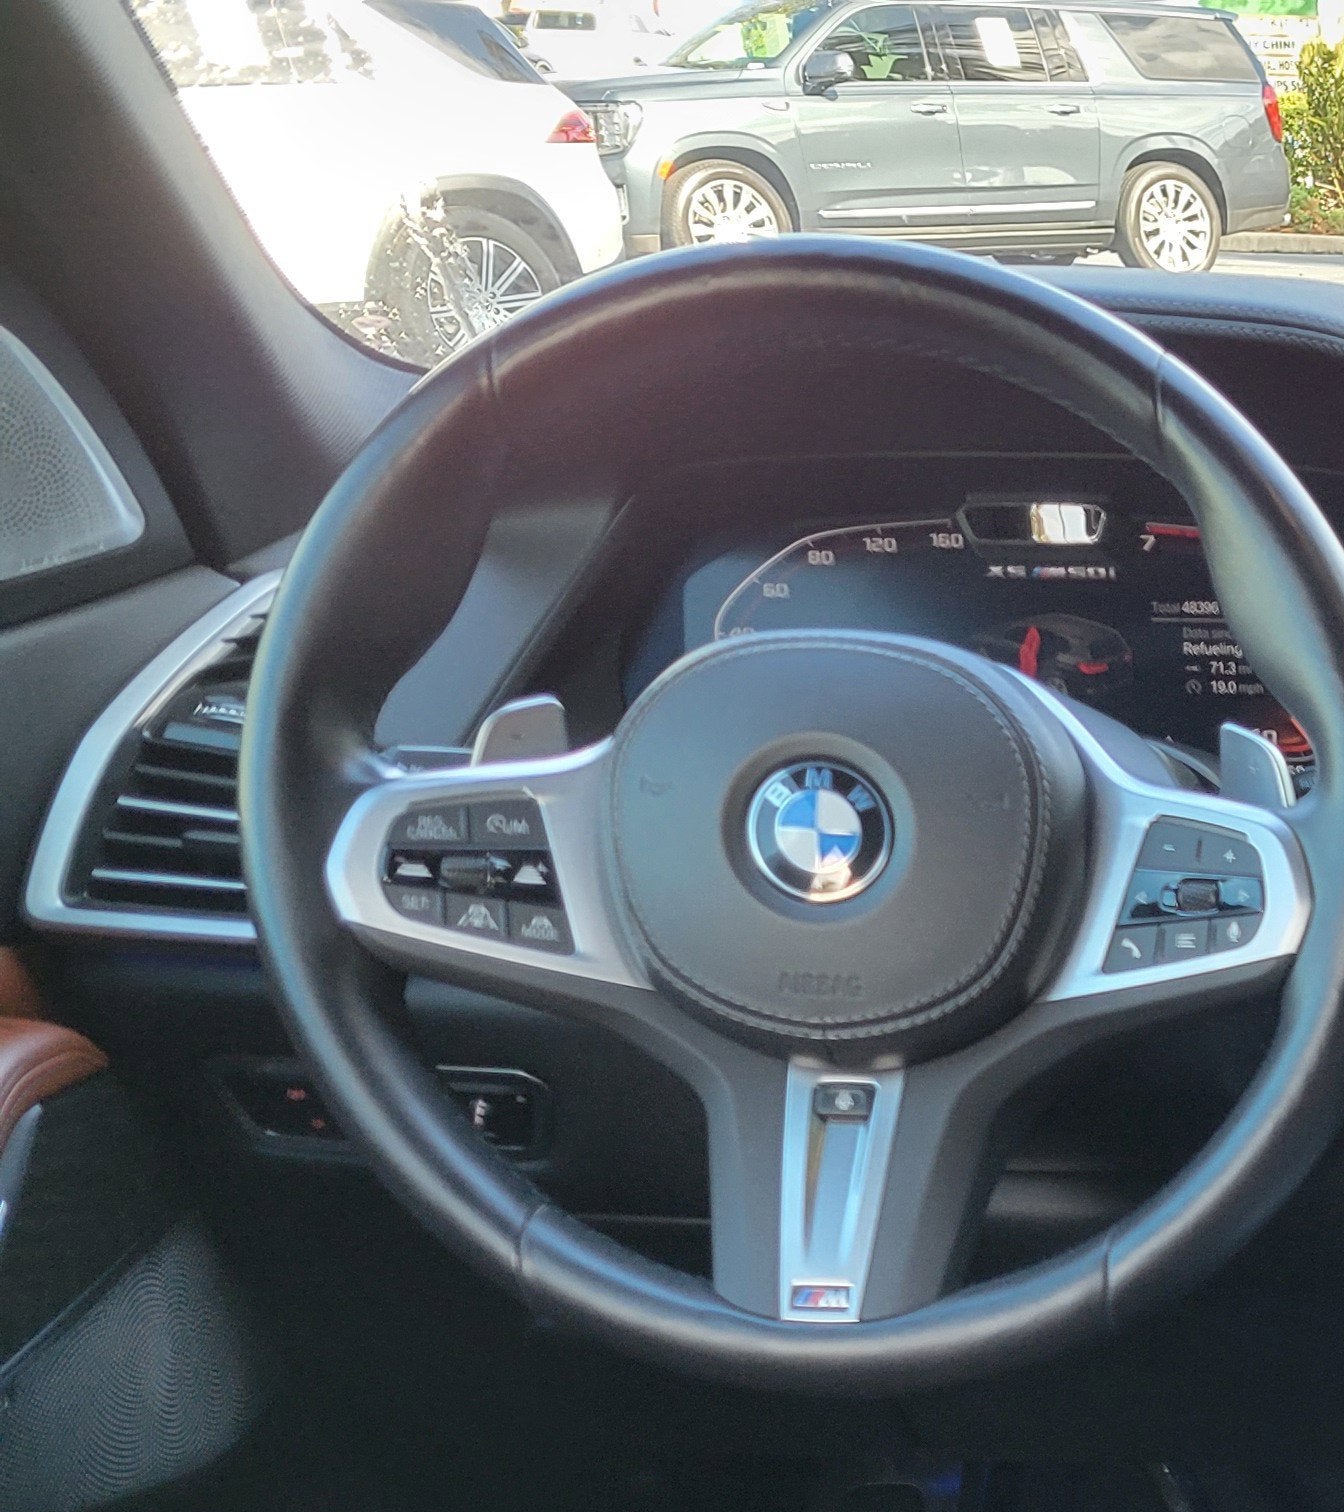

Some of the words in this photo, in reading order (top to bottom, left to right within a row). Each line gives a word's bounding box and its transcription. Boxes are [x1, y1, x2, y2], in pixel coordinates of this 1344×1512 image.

[863, 537, 898, 553] 120
[929, 533, 964, 550] 160
[1139, 534, 1156, 551] 7
[808, 550, 836, 566] 80
[763, 583, 790, 599] 60
[1183, 641, 1243, 659] Refueling
[1209, 661, 1238, 676] 71.3
[1210, 680, 1238, 695] 19.0
[763, 767, 878, 813] BMW
